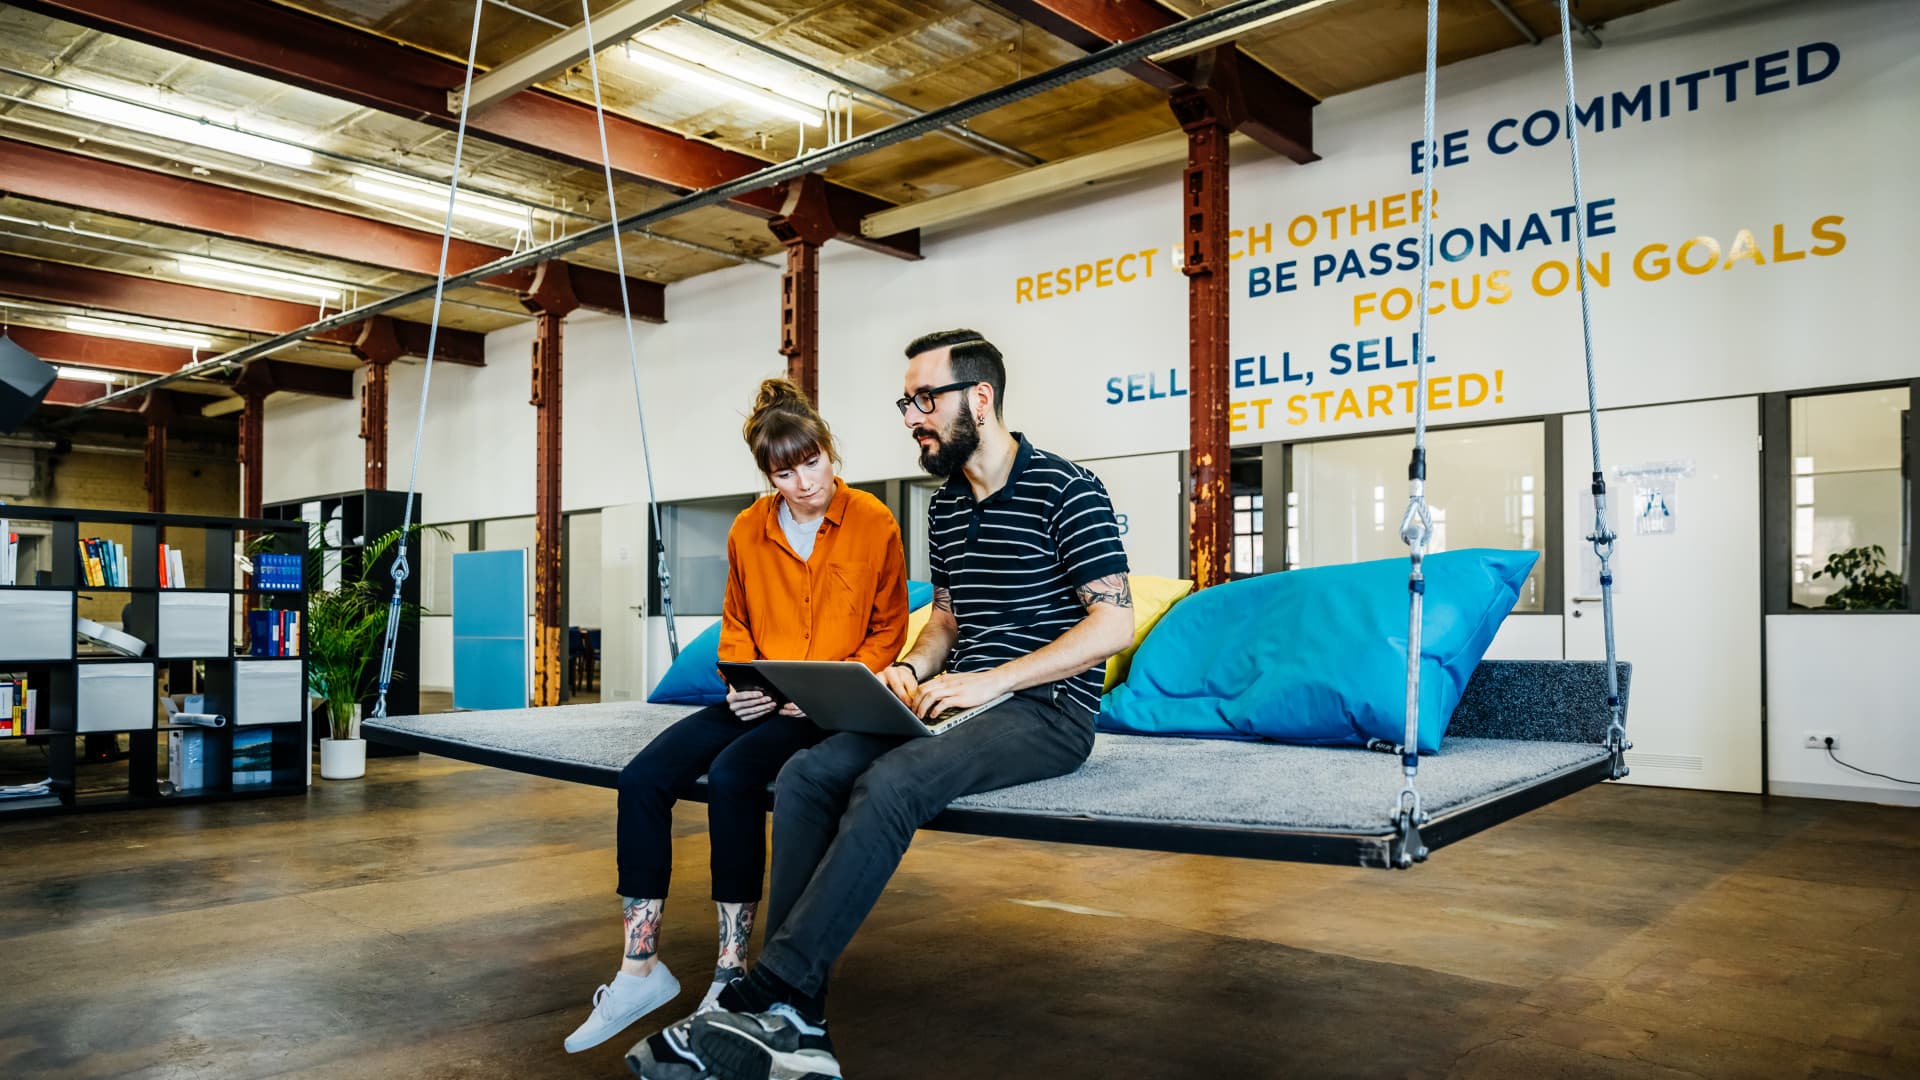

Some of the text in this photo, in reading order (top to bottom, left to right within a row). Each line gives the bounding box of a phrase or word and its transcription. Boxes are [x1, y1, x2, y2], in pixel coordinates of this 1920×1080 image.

[1411, 42, 1841, 175] BE COMMITTED
[1016, 248, 1159, 304] RESPECT
[1288, 188, 1438, 248] OTHER
[1249, 198, 1616, 298] BE PASSIONATE
[1353, 215, 1847, 327] FOCUS ON GOALS
[1229, 369, 1504, 433] ET STARTED!
[1234, 351, 1314, 389] ELL,
[1330, 332, 1436, 376] SELL
